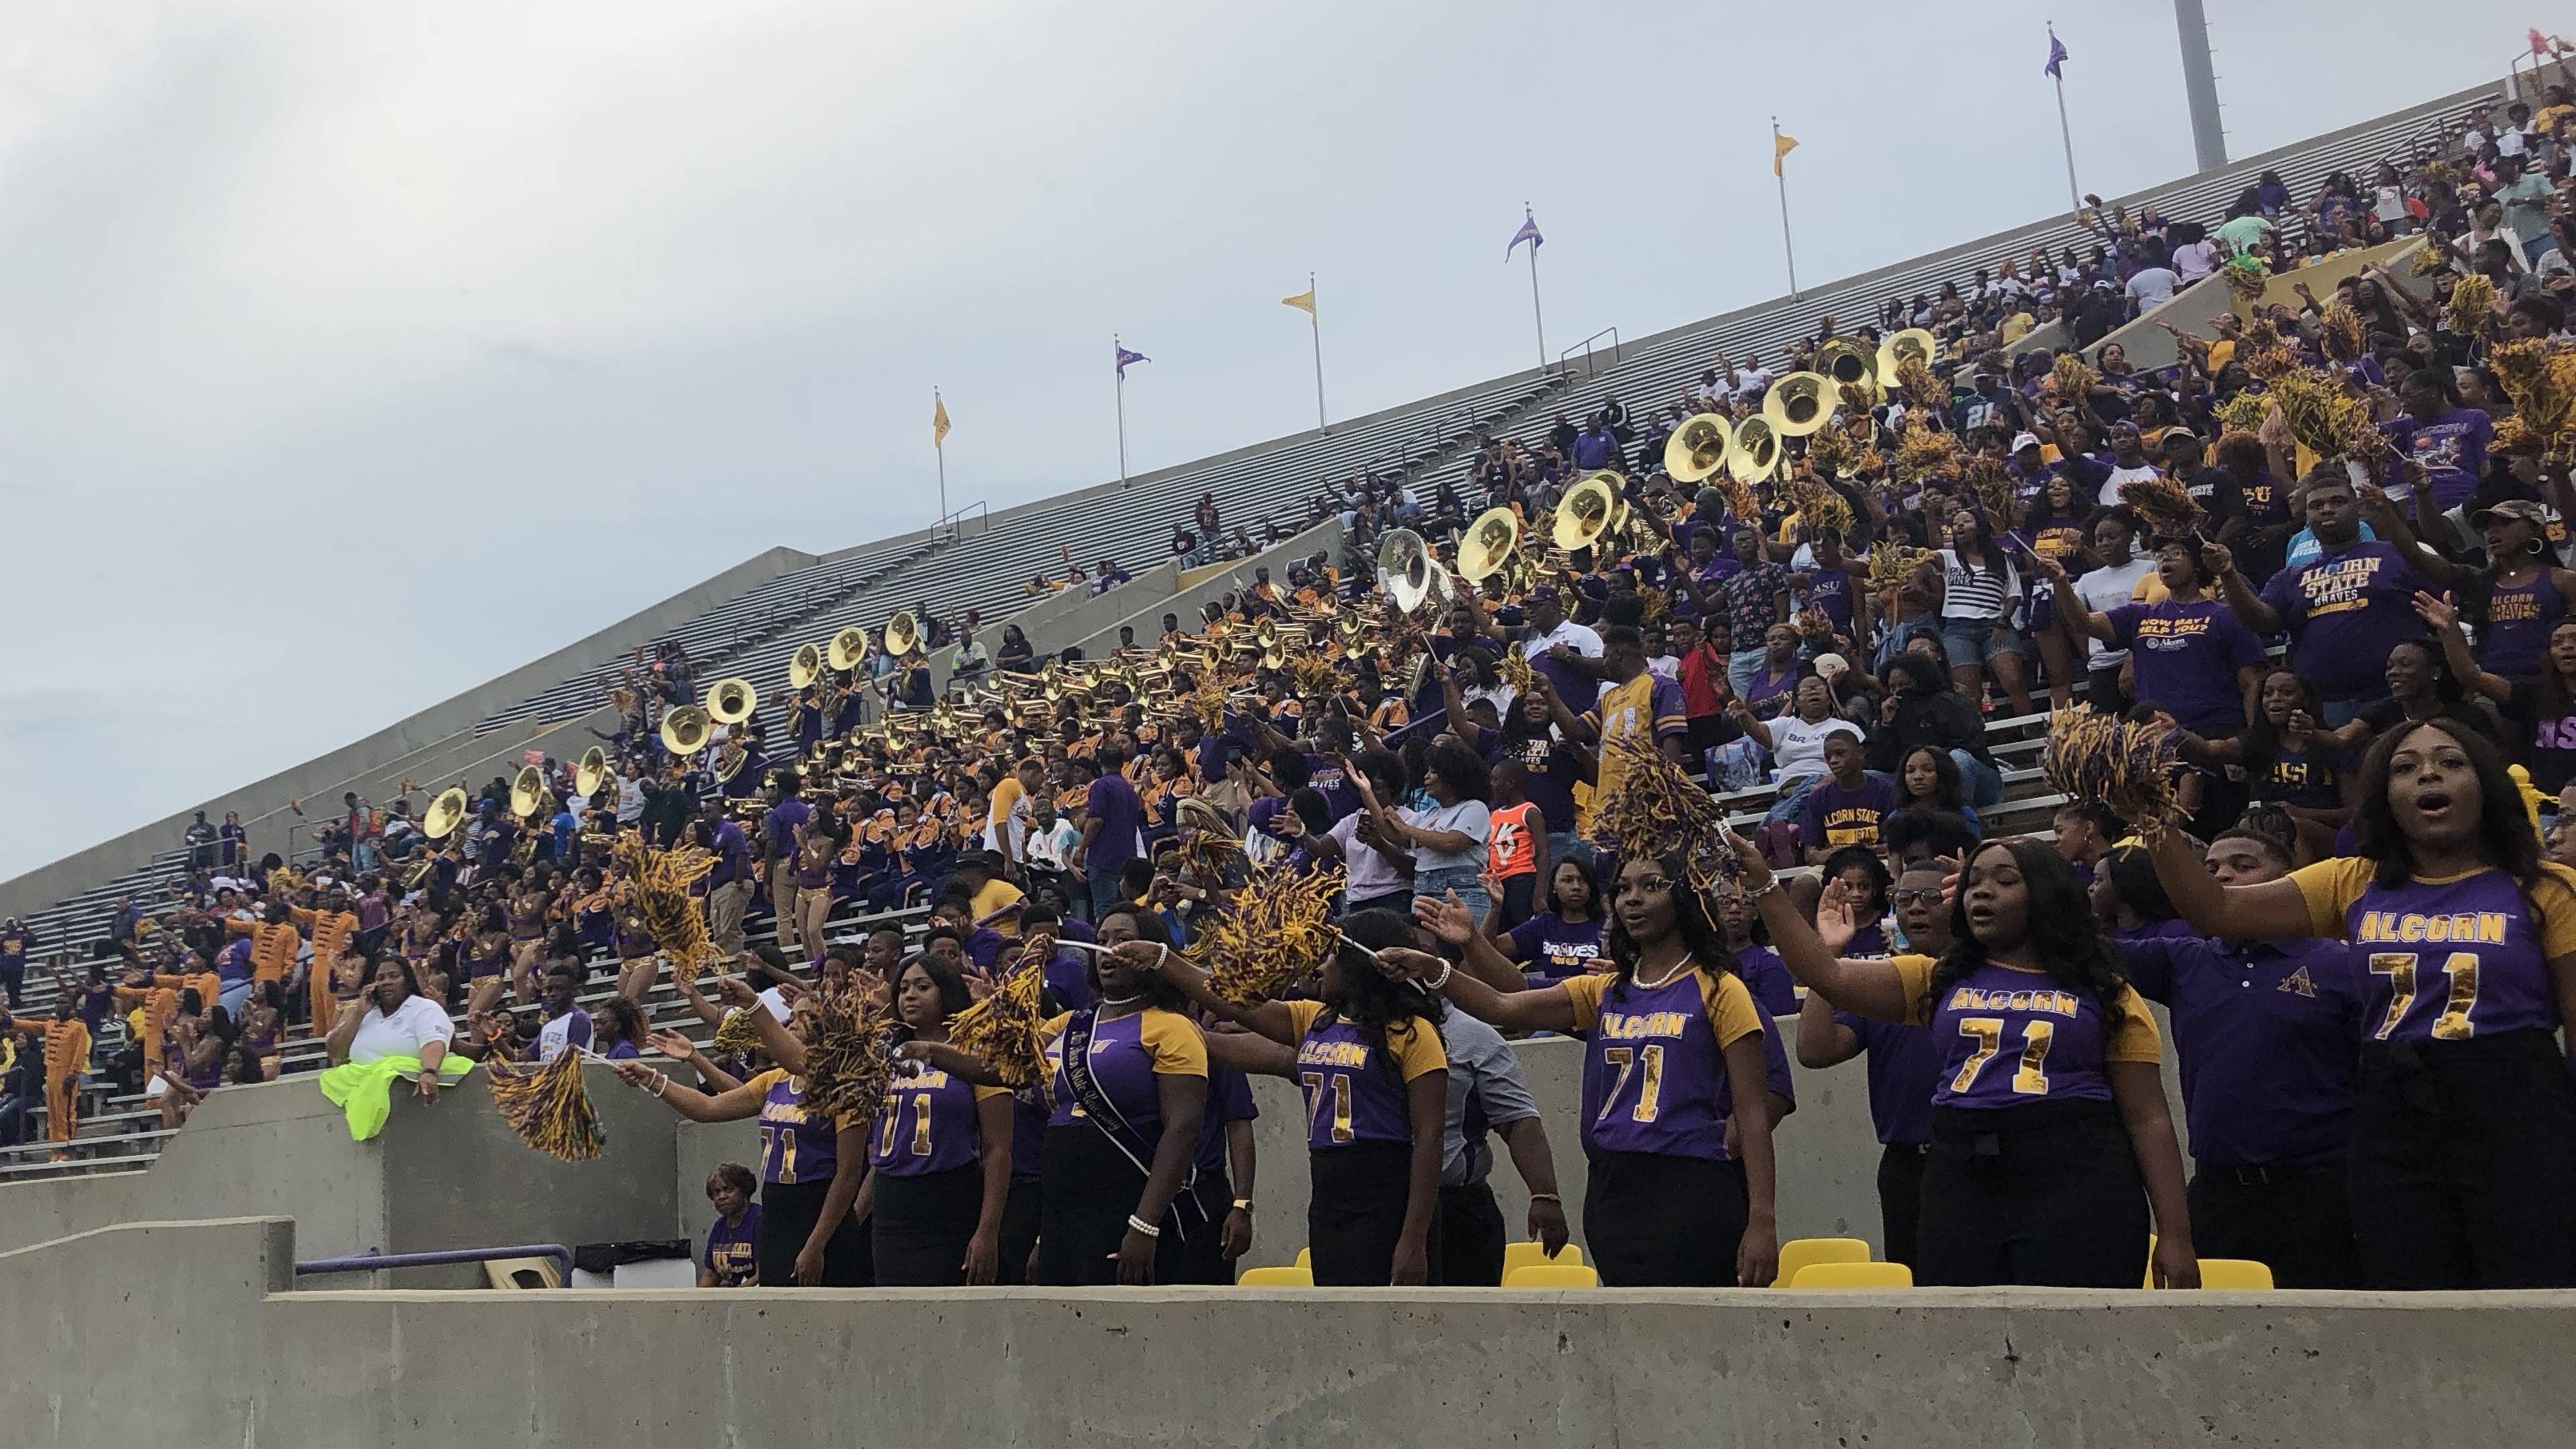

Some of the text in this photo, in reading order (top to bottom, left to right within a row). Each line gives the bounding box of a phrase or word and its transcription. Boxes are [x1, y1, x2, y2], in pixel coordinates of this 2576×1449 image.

[1814, 581, 1840, 593] ASU
[2304, 571, 2369, 598] STATE
[2314, 590, 2358, 607] BRAVES
[2491, 593, 2534, 605] ALCORN
[2175, 617, 2203, 626] MAY
[1509, 756, 1542, 764] AVES
[1856, 808, 1881, 824] STATE
[2357, 911, 2506, 945] ALCORN
[1947, 987, 2078, 1018] ALCORN
[2369, 952, 2479, 1040] 71
[1950, 1018, 2054, 1094] 71
[1598, 1044, 1665, 1123] 71
[1302, 1071, 1355, 1143] 71
[760, 1125, 797, 1184] 71
